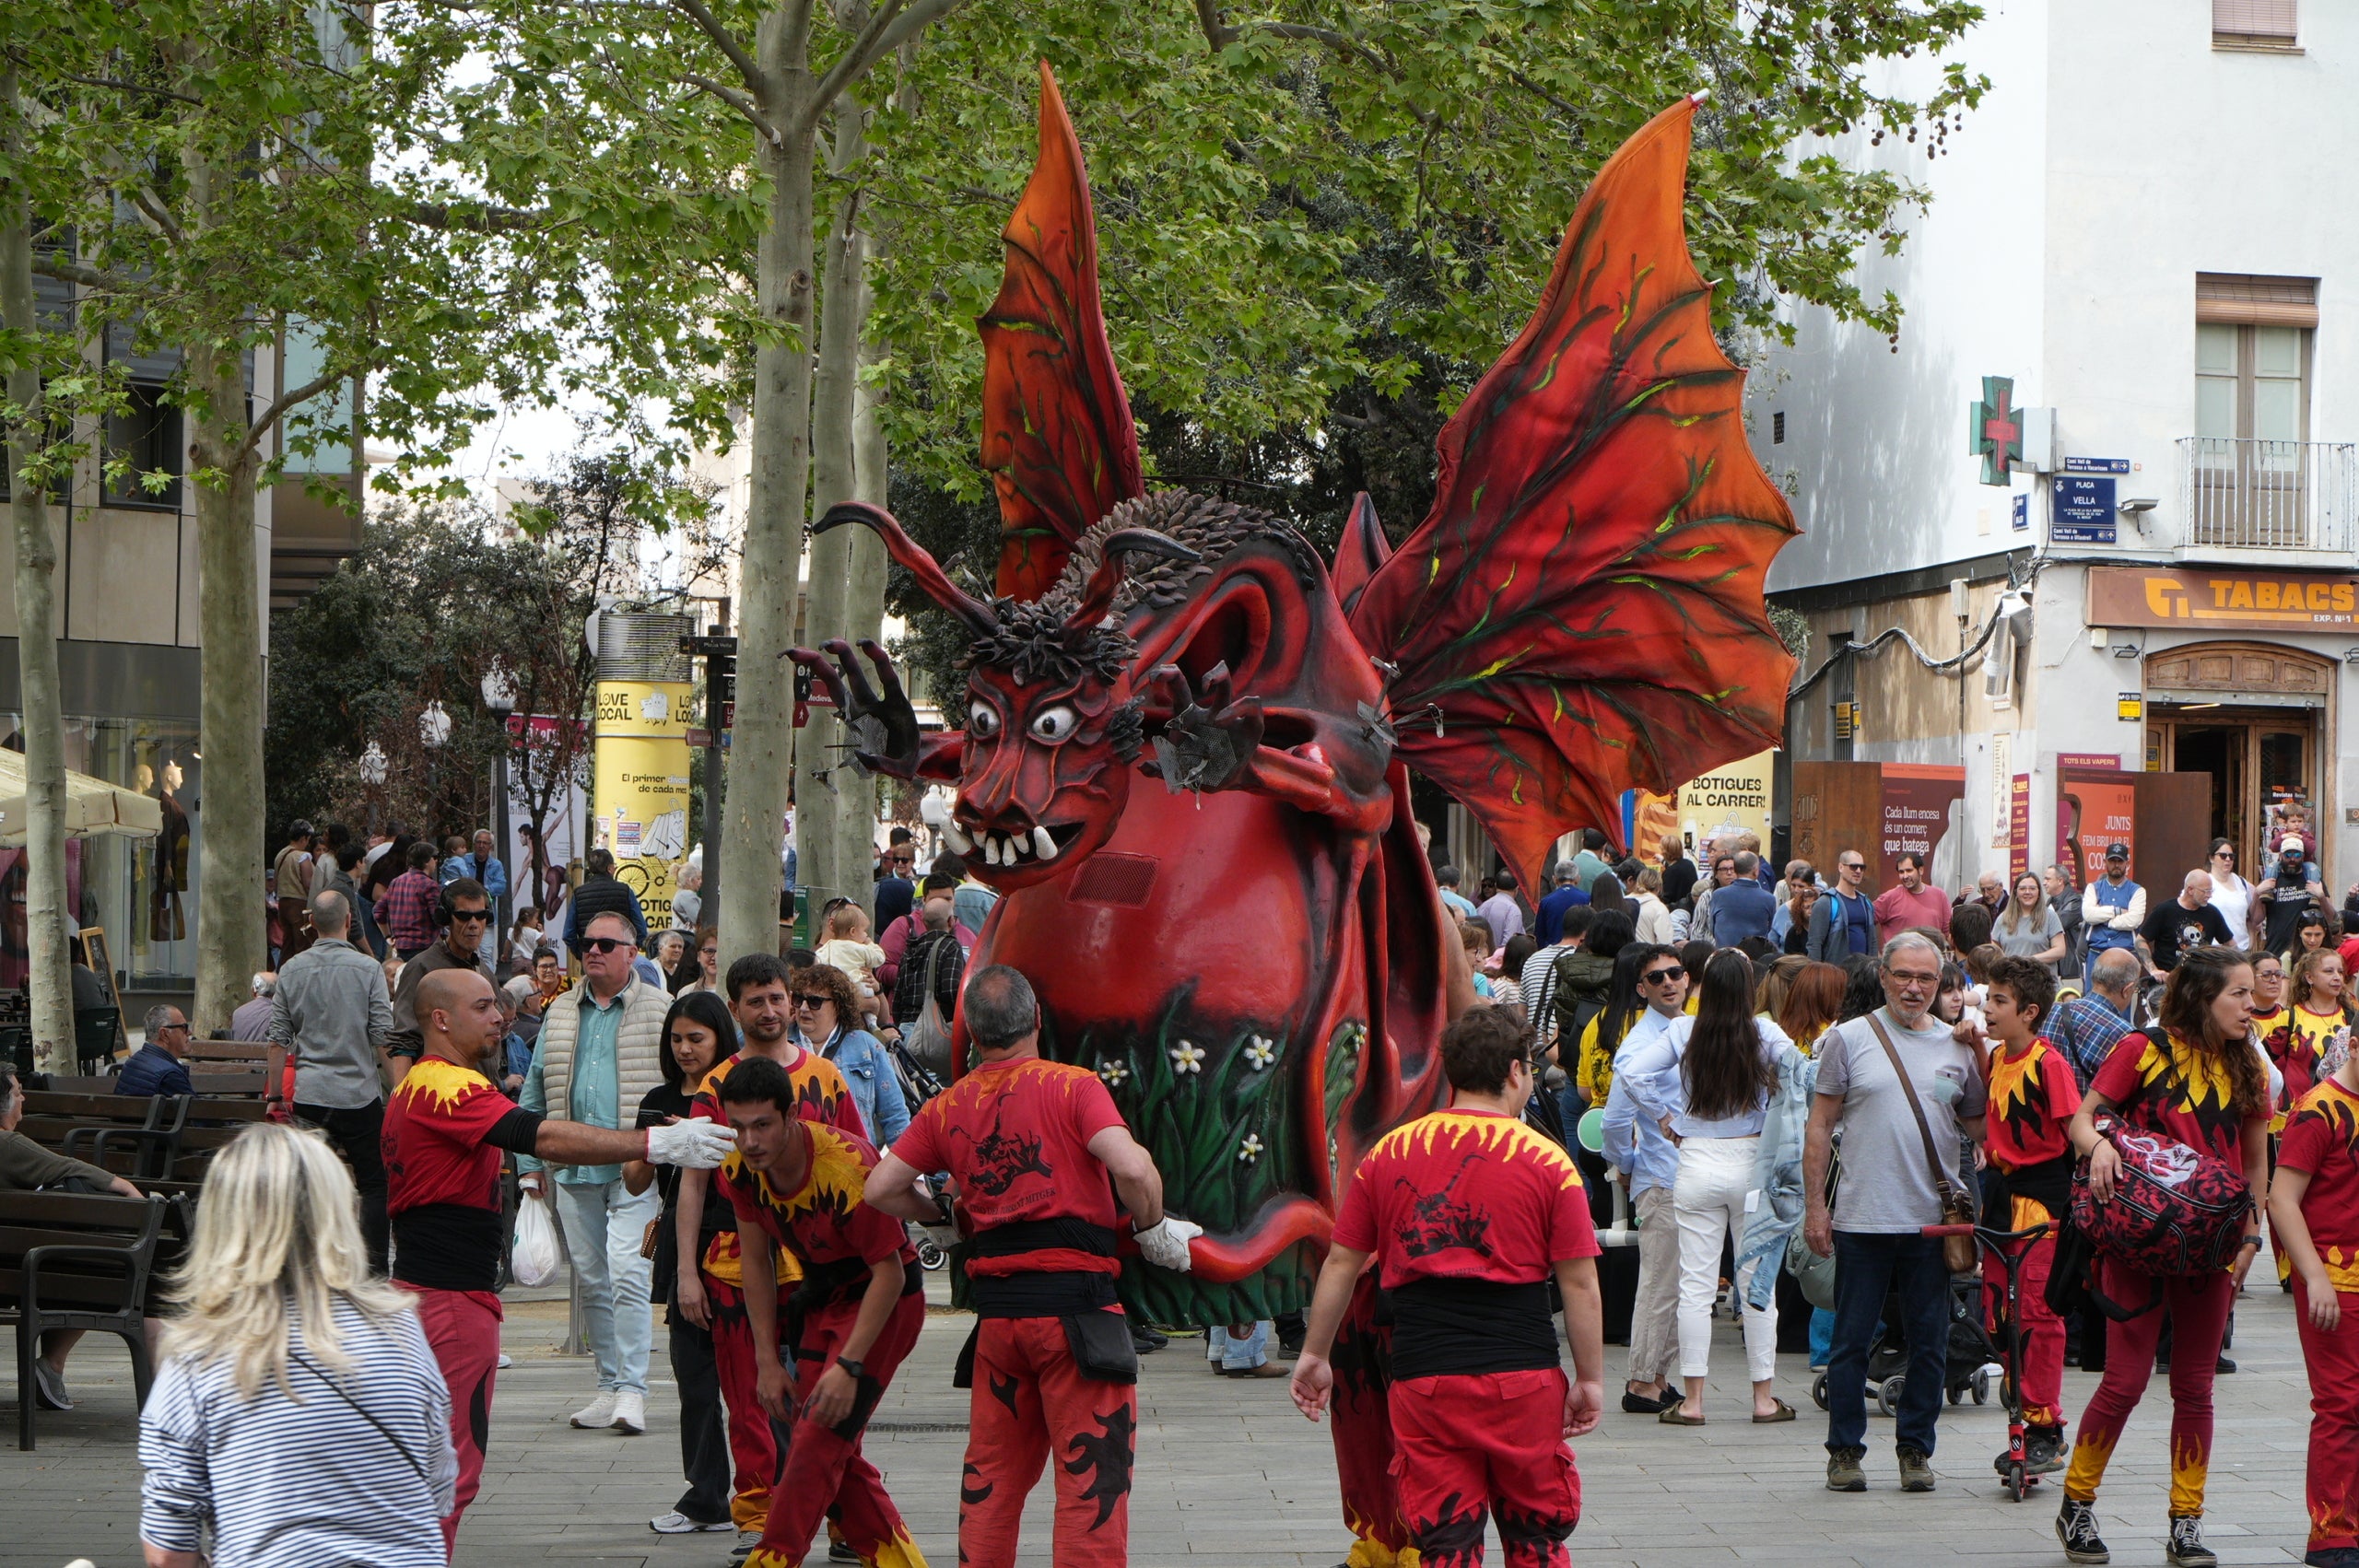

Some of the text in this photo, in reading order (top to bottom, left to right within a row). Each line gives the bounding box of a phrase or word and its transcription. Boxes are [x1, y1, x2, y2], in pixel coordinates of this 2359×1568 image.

[2073, 496, 2096, 505] VELLA
[2209, 579, 2354, 612] TABACS
[2314, 614, 2333, 623] EXP.
[598, 693, 628, 707] LOVE
[596, 708, 632, 721] LOCAL
[621, 773, 629, 782] El
[632, 773, 665, 784] primer
[1692, 777, 1762, 791] BOTIGUES
[638, 784, 651, 793] de
[652, 784, 675, 794] cada
[1685, 793, 1766, 808] AL CARRER!
[1884, 806, 1940, 820] Cada llum encesa
[1884, 821, 1928, 837] és un comerç
[2105, 815, 2131, 831] JUNTS
[1884, 836, 1930, 857] que batega
[2083, 835, 2095, 847] FEM
[2123, 837, 2131, 848] EL
[2278, 894, 2308, 902] EQUIPMEN
